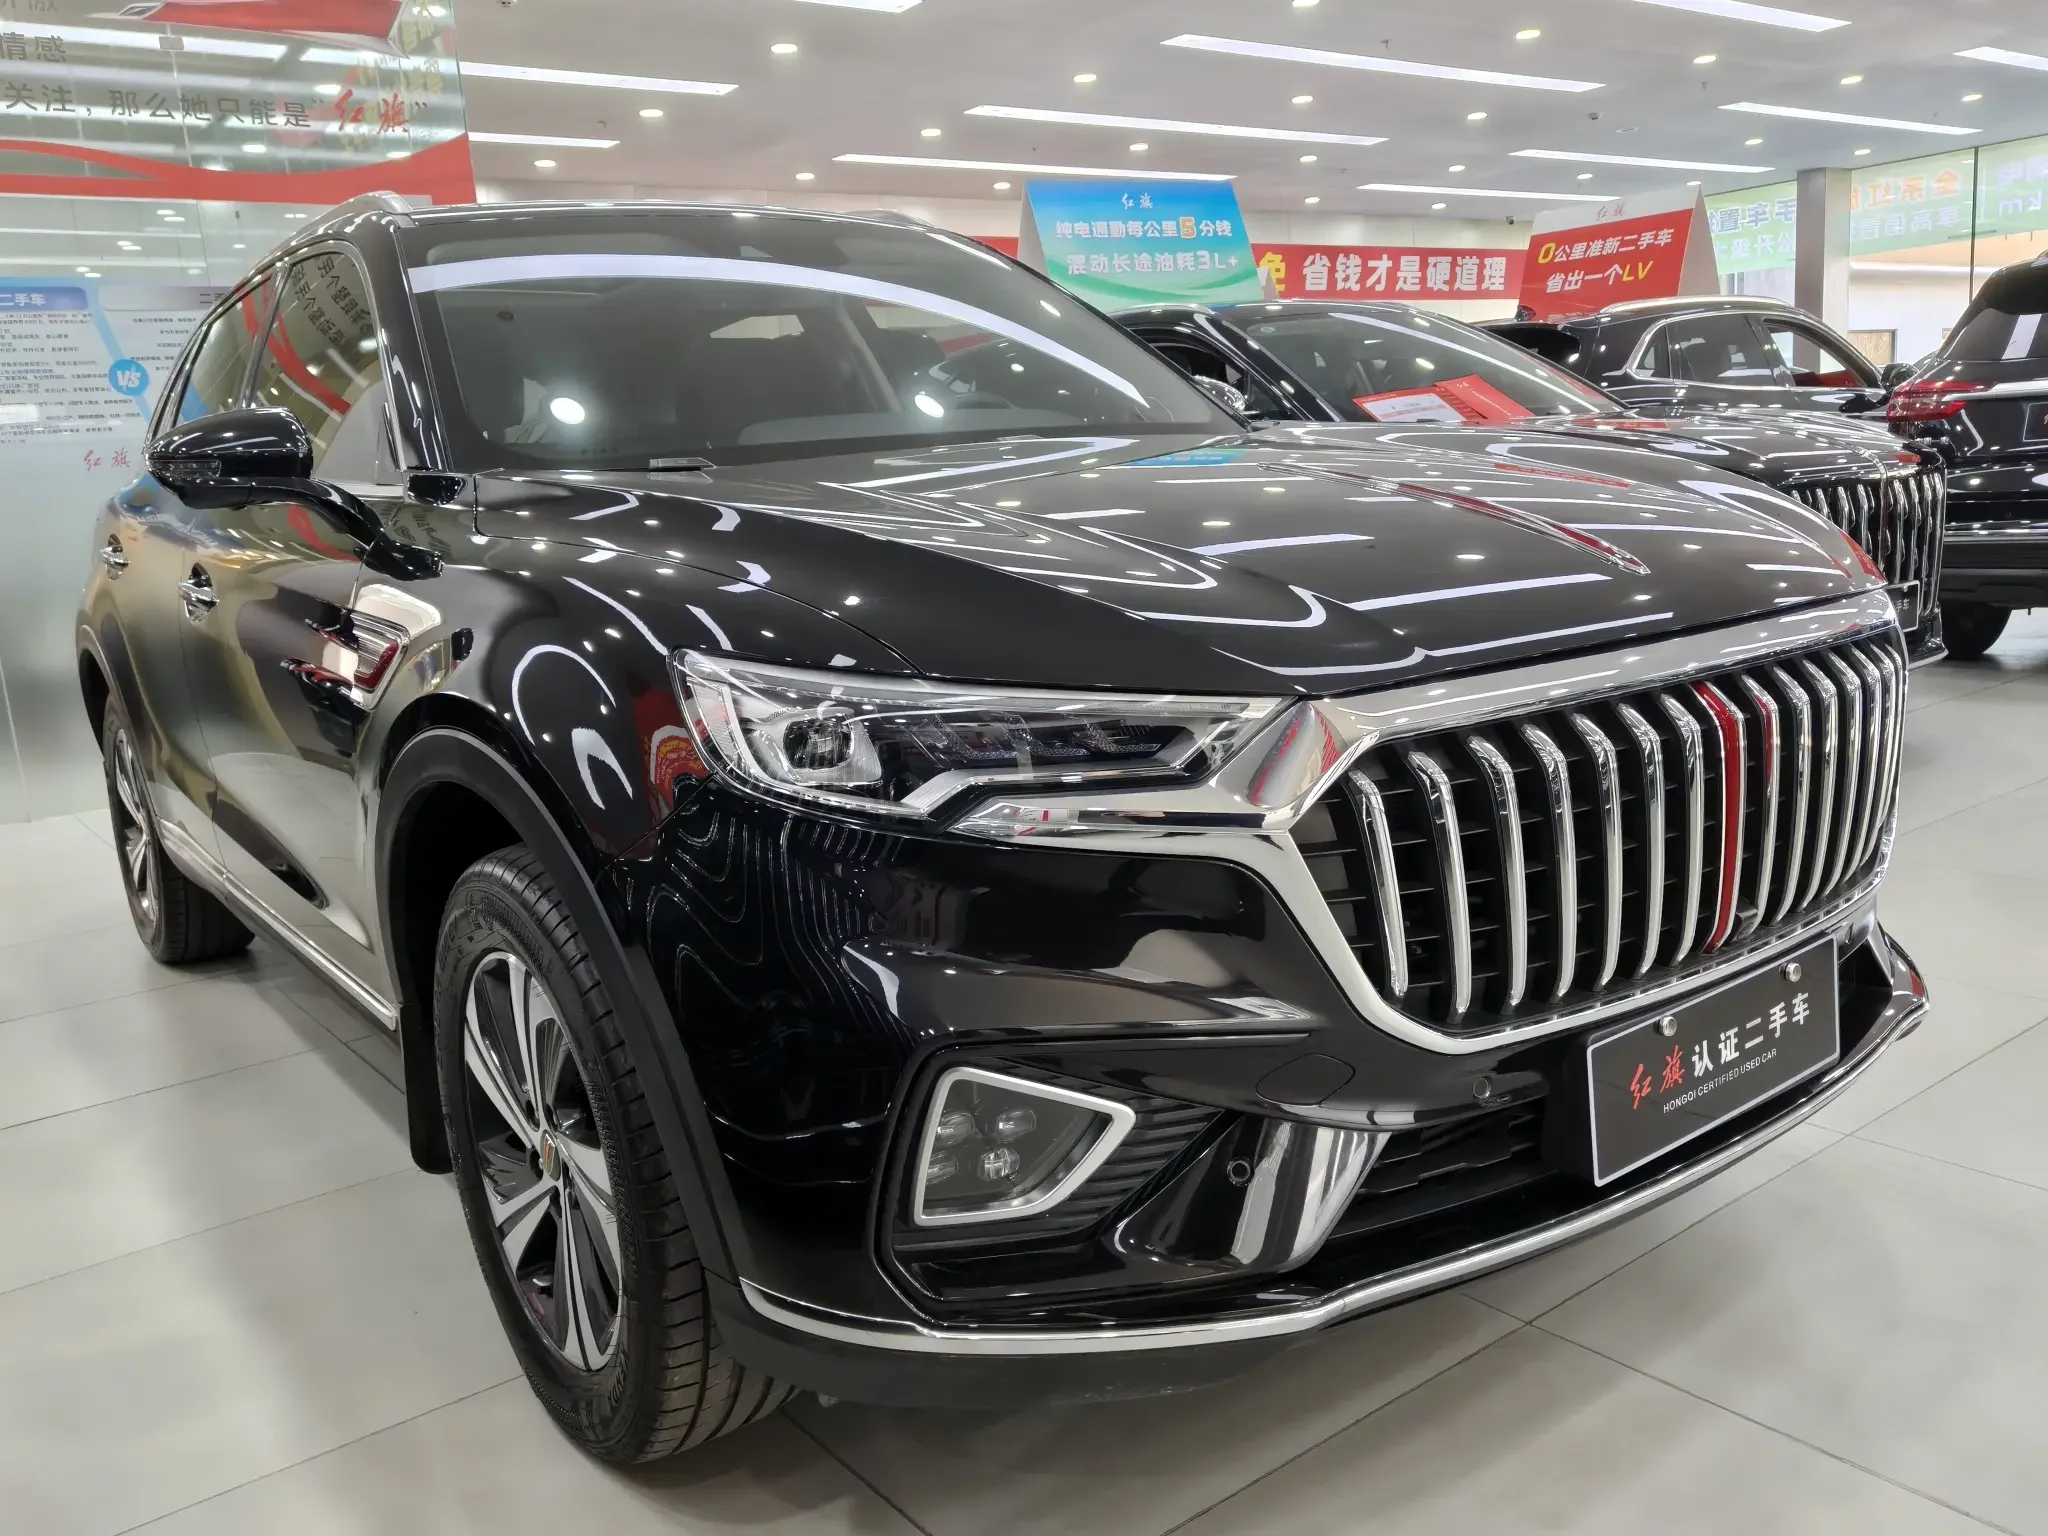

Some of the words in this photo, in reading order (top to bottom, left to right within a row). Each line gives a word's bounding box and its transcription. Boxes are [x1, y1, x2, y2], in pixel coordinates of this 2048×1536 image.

[0, 32, 66, 63] 情感
[1121, 193, 1153, 209] 红旗
[1302, 252, 1507, 293] 省钱才是硬道理
[116, 369, 141, 390] VS
[1663, 1090, 1697, 1114] HONGQI
[1697, 1068, 1740, 1097] CERTIFIED
[1740, 1056, 1761, 1074] USED
[1762, 1048, 1777, 1063] CAR
